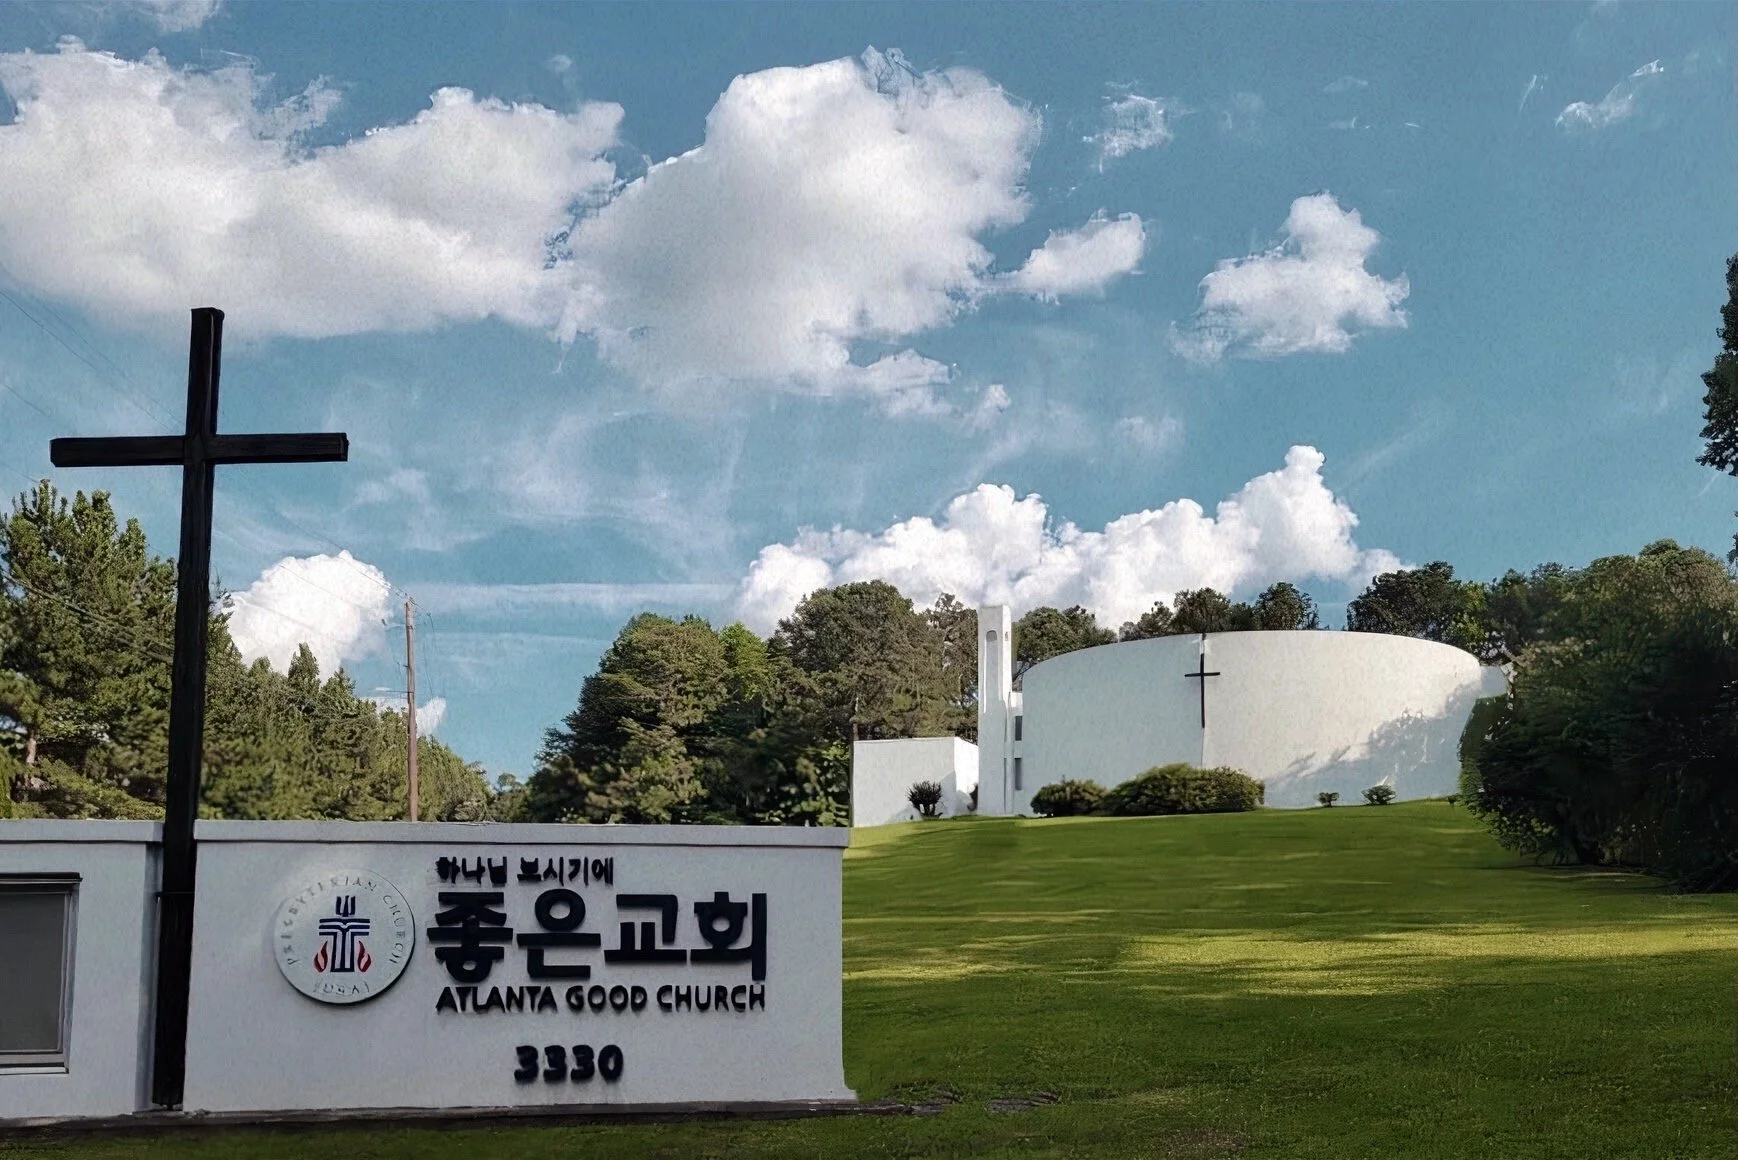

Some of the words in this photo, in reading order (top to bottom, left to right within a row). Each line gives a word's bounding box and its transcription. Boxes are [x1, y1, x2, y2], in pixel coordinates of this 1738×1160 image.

[516, 856, 614, 887] 보시기에
[426, 888, 768, 983] 좋은교회
[435, 985, 558, 1013] ATLANTA
[565, 984, 648, 1012] GOOD
[656, 984, 766, 1012] CHURCH
[514, 1044, 624, 1084] 3330
